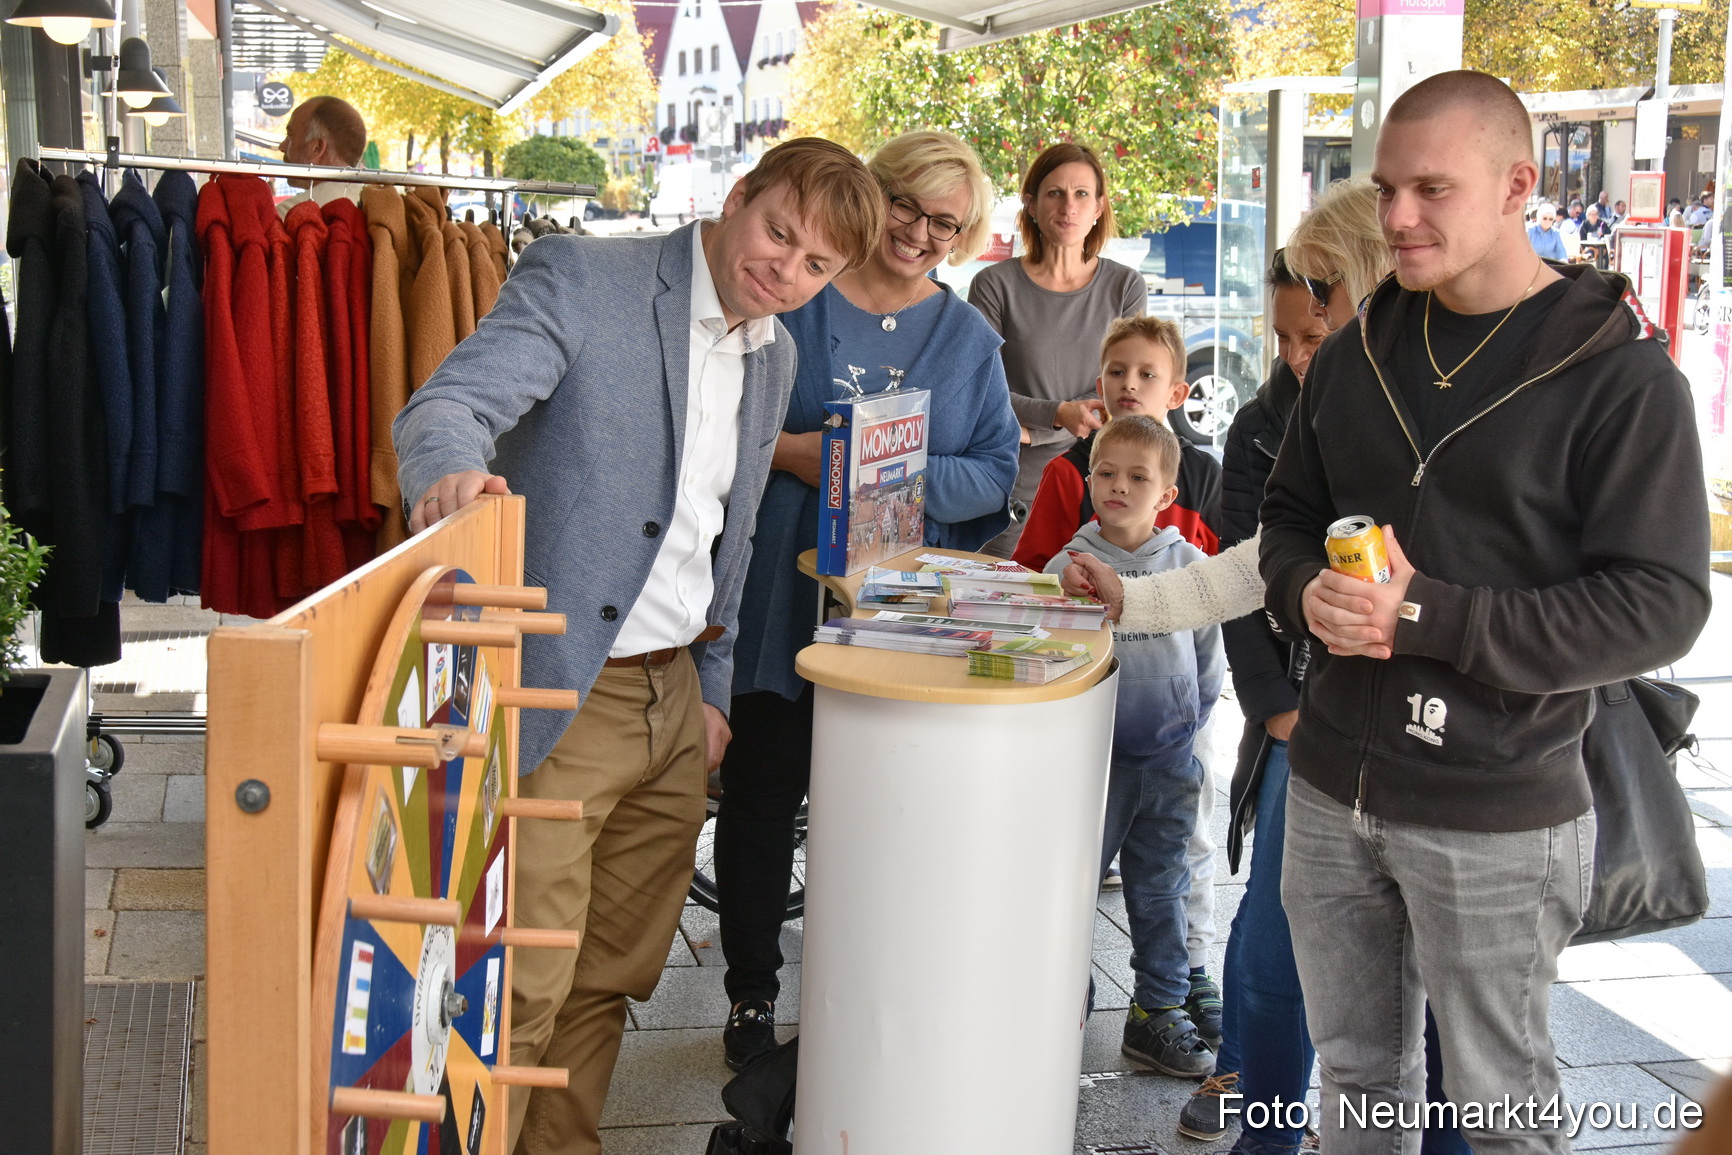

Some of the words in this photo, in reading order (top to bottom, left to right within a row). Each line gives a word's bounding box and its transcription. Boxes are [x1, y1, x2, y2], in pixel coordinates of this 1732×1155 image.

[861, 419, 924, 461] MONOPOLY
[830, 441, 842, 508] MONOPOLY
[879, 465, 905, 483] NEUMARKT
